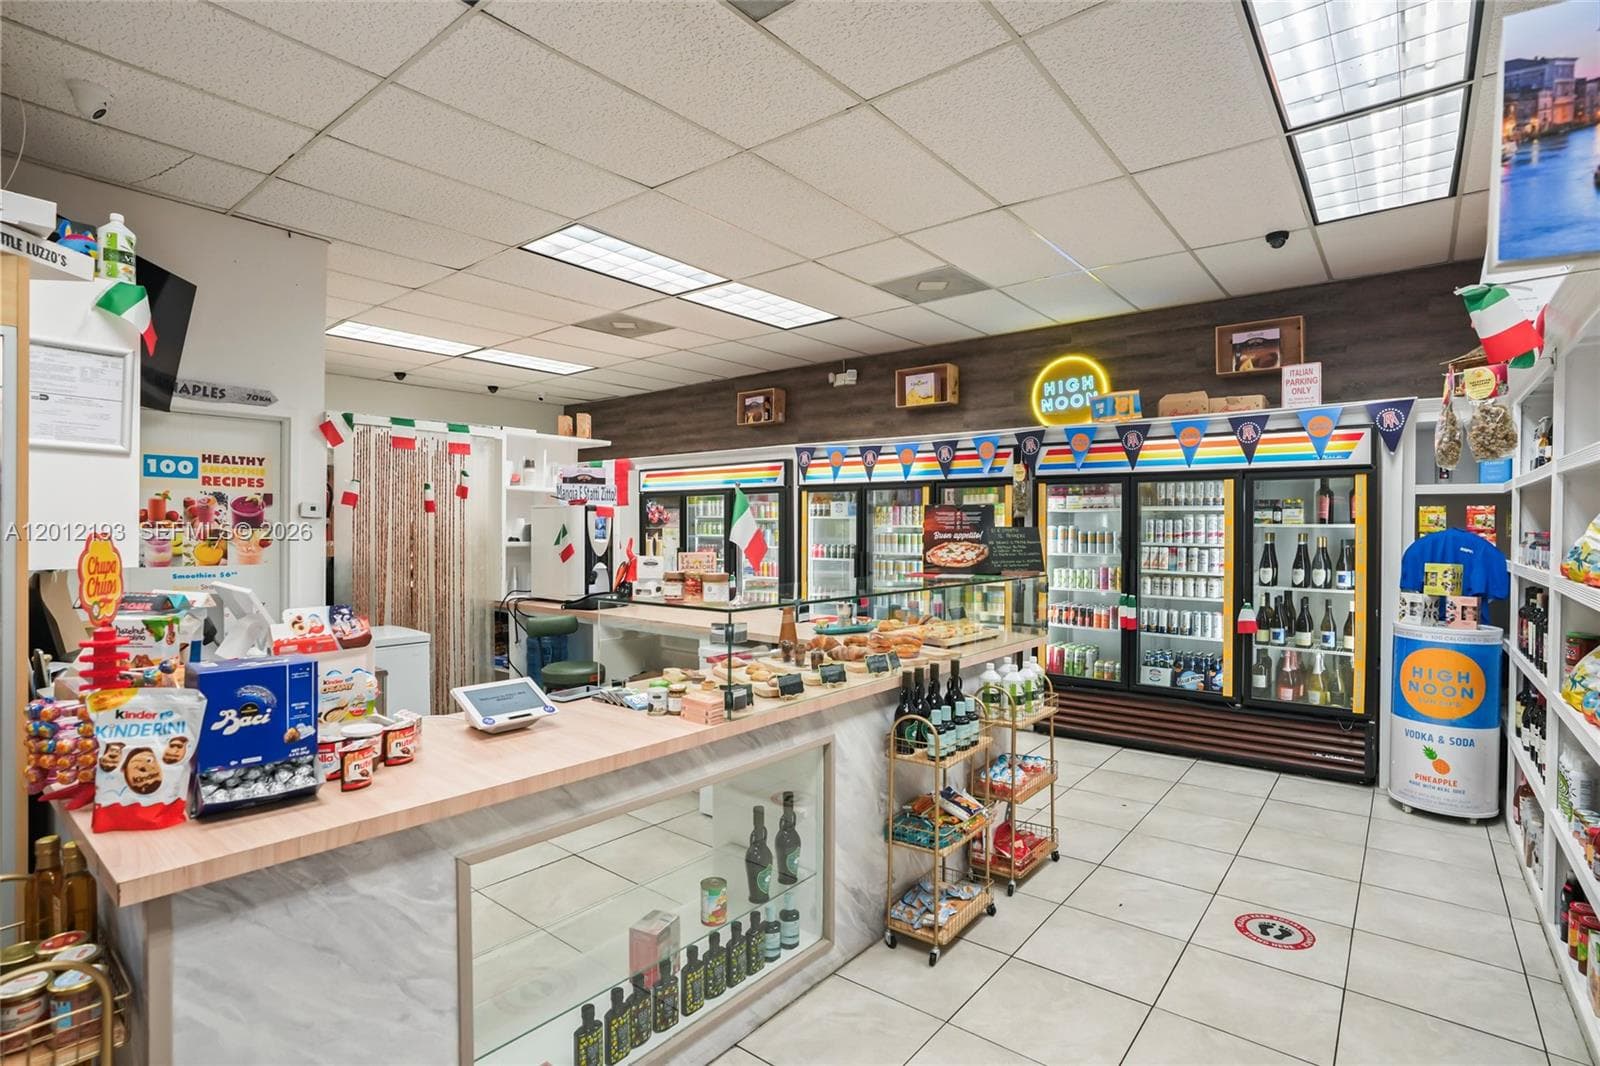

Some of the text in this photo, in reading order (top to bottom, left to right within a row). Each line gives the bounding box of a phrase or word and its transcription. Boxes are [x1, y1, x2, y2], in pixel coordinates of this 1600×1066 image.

[26, 241, 67, 267] LUZZO'S
[1290, 368, 1313, 377] ITALIAN
[1043, 375, 1094, 396] HIGH
[1286, 377, 1318, 386] PARKING
[1292, 387, 1311, 395] ONLY
[147, 459, 193, 474] 100
[201, 454, 266, 466] HEALTHY
[201, 476, 265, 488] RECIPES
[87, 556, 117, 579] Chupa
[86, 576, 117, 598] Chups
[1412, 666, 1470, 684] HIGH
[1408, 680, 1474, 699] NOON
[115, 709, 157, 719] Kinder
[210, 708, 272, 736] Baci
[1404, 728, 1475, 747] VODKA & SODA
[1414, 773, 1458, 788] PINEAPPLE
